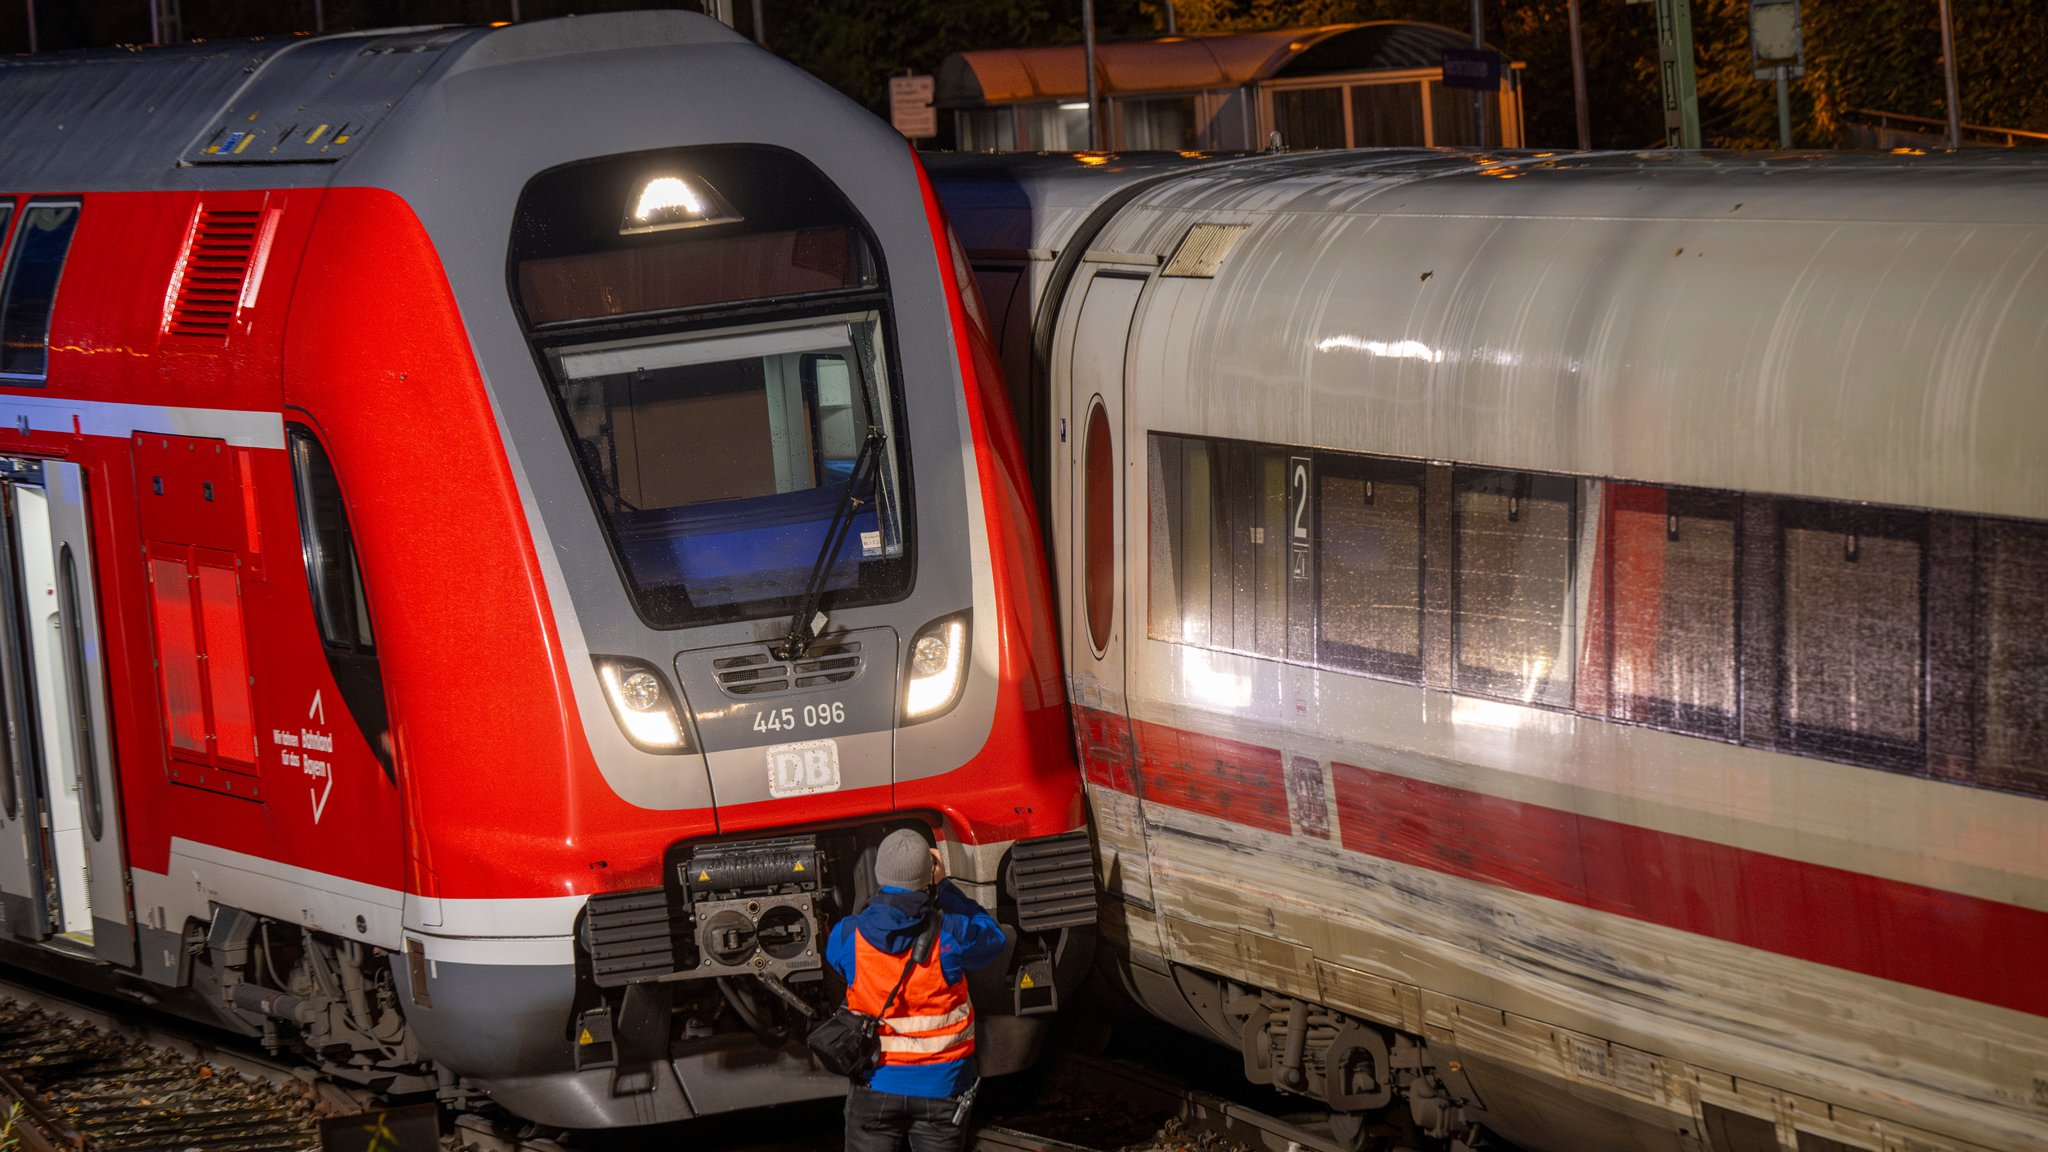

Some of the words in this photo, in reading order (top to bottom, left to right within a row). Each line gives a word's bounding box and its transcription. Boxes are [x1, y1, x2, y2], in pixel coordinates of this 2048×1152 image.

[1294, 464, 1307, 538] 2
[753, 707, 795, 733] 445
[803, 701, 845, 727] 096
[301, 728, 333, 752] Bahnland
[302, 753, 326, 779] Bayern
[776, 749, 832, 788] DB
